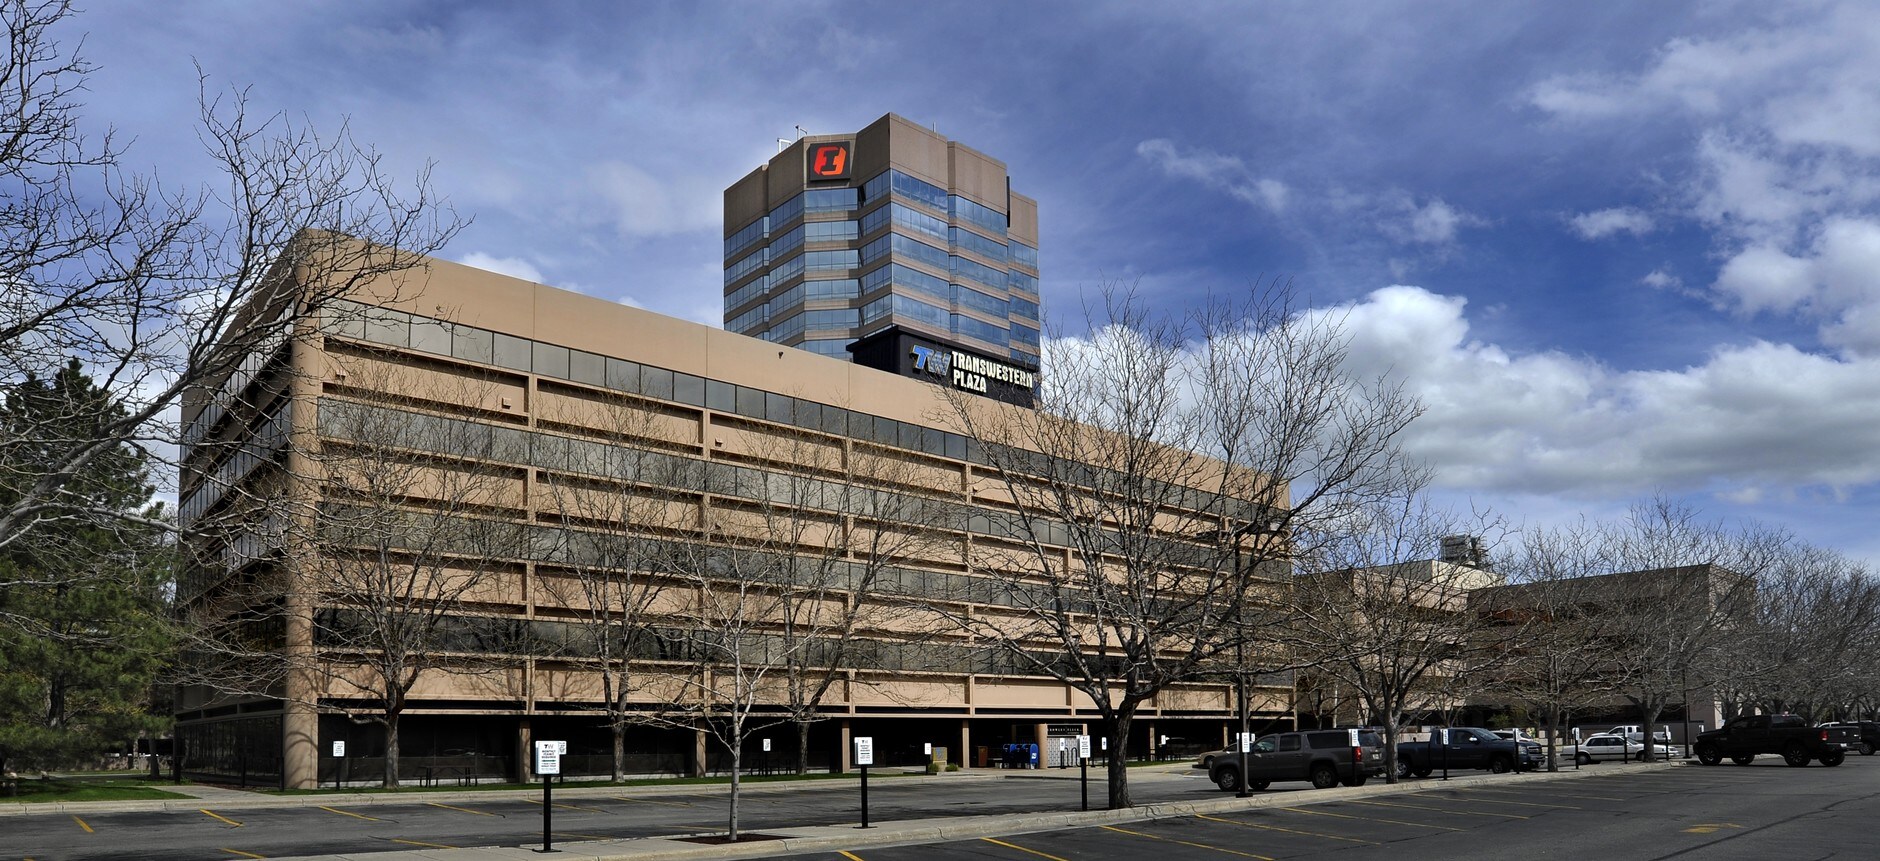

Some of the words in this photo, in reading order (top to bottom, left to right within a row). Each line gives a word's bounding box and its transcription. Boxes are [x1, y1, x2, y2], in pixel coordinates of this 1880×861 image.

[911, 344, 951, 376] TW
[951, 350, 1033, 389] TRANSWESTERN
[953, 369, 987, 393] PLAZA
